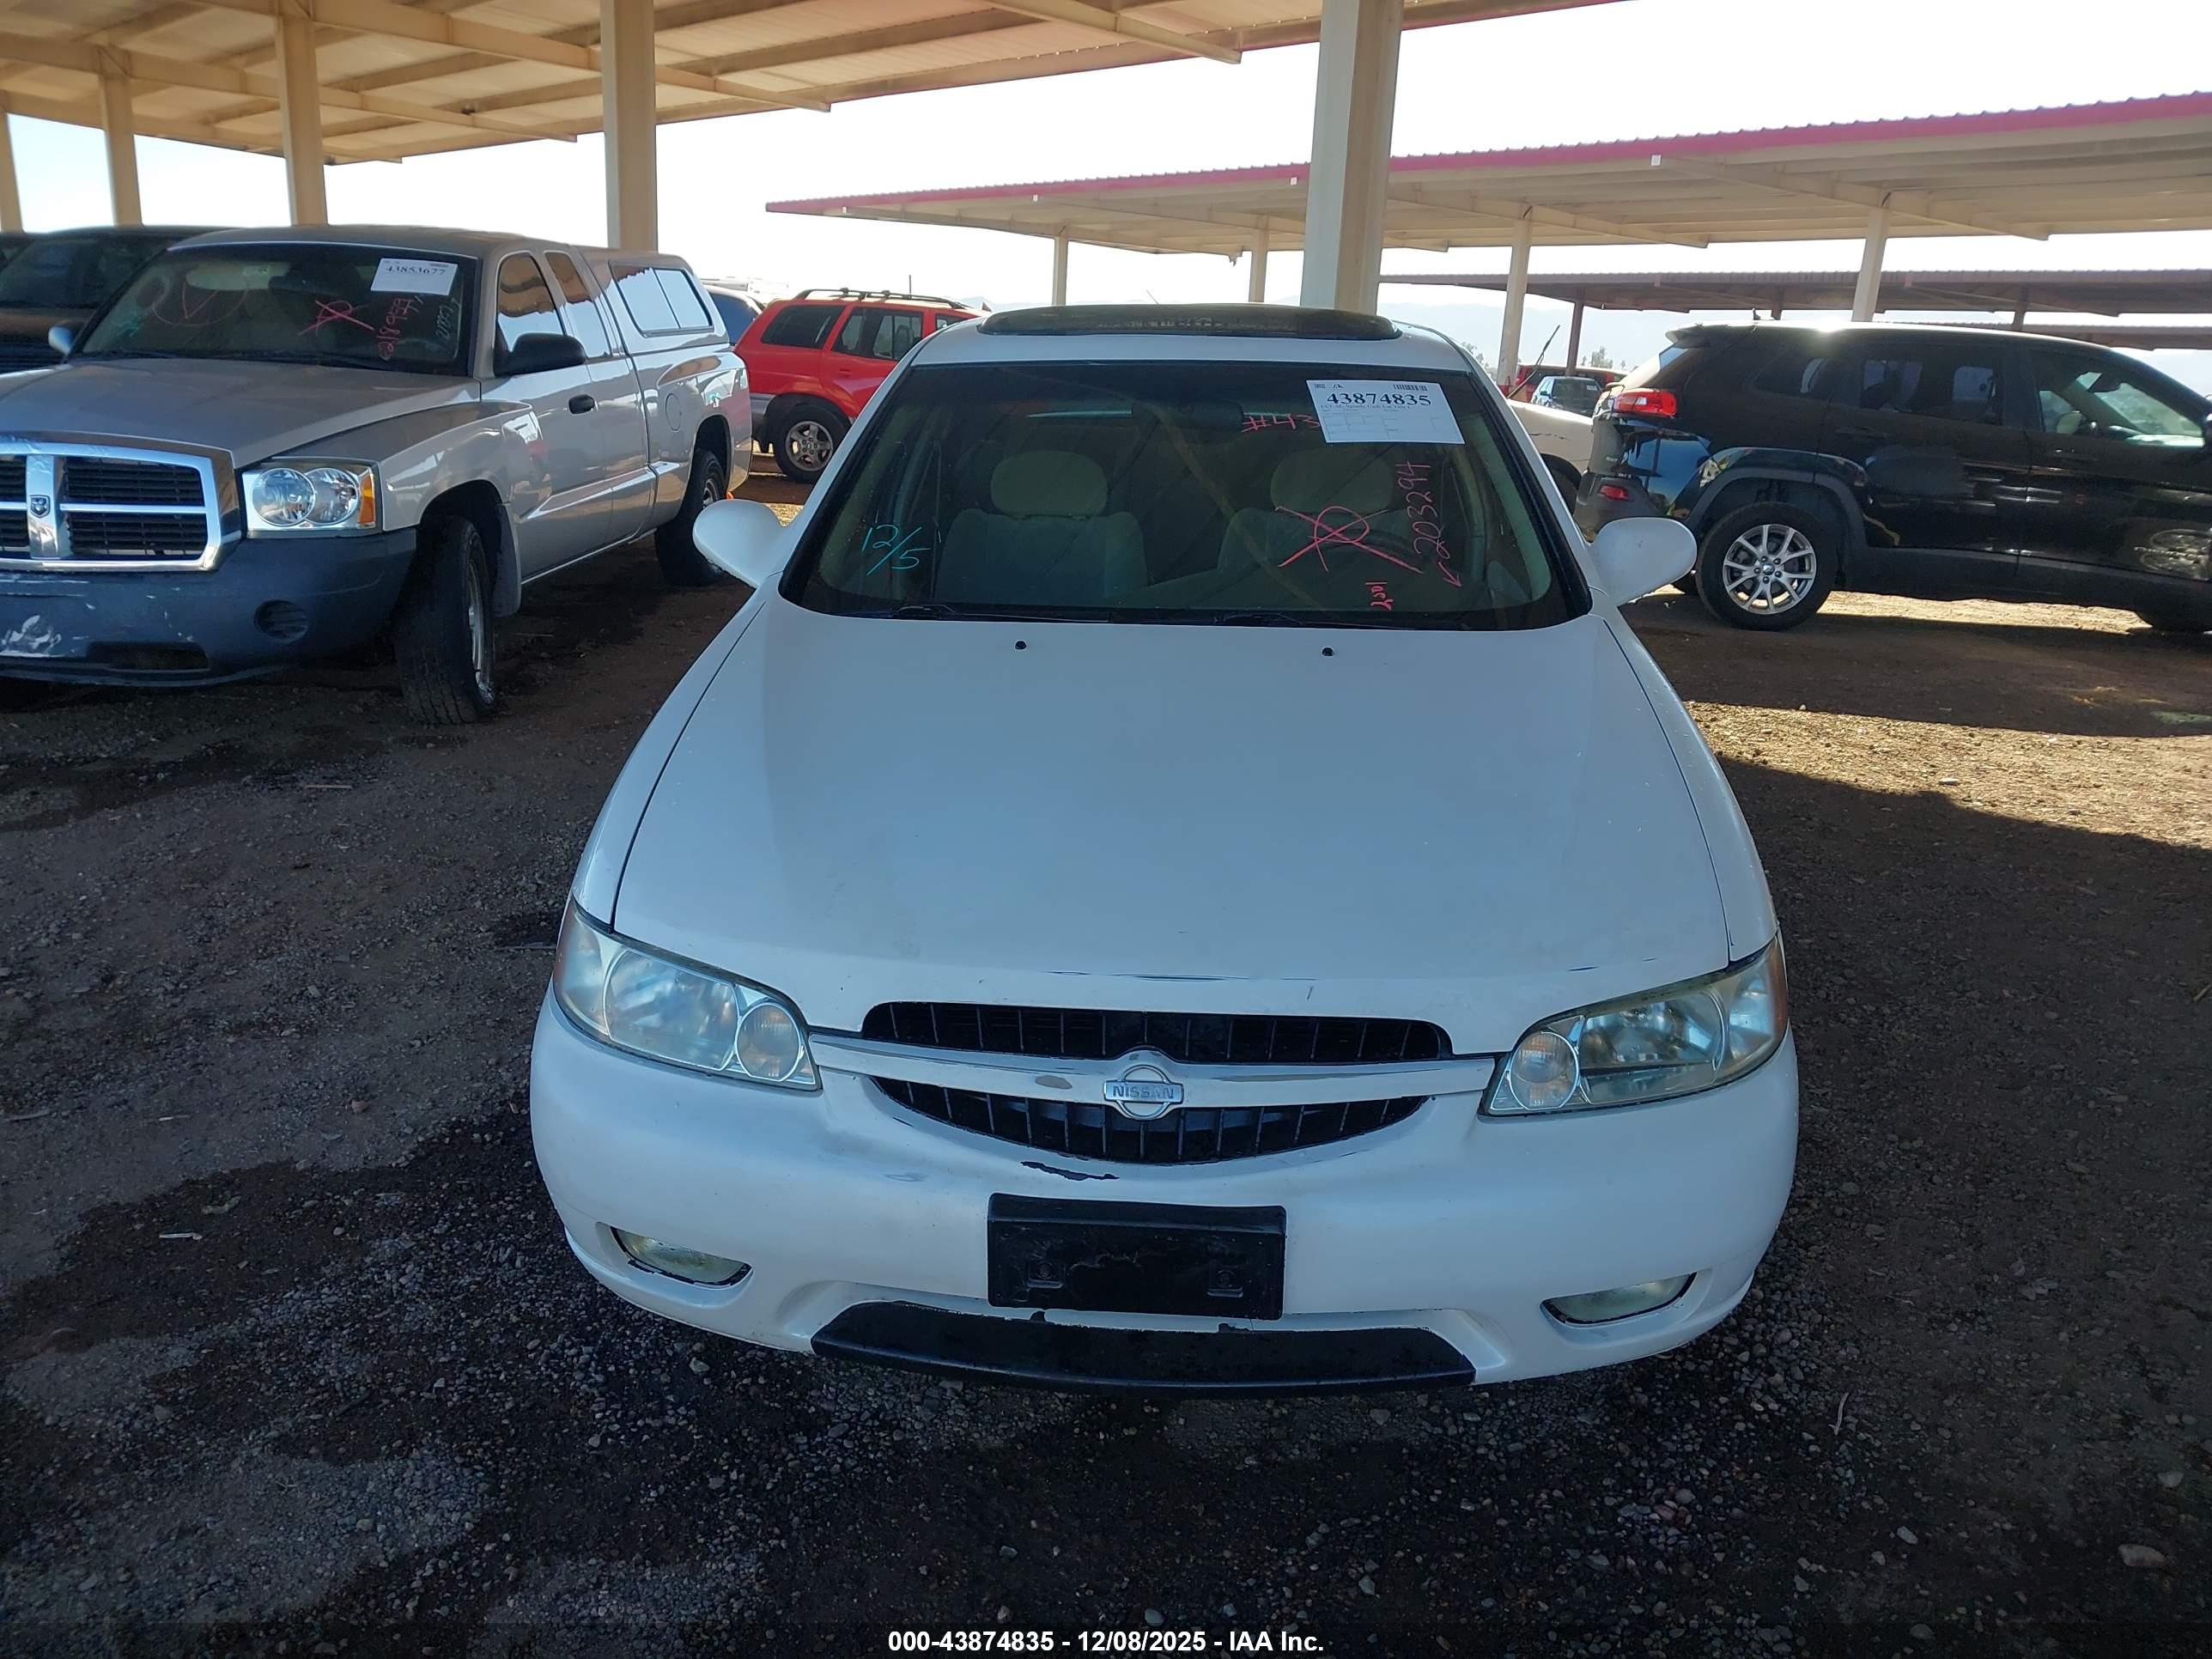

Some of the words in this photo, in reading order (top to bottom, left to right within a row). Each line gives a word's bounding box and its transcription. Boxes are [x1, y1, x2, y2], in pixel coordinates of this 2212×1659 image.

[1327, 392, 1431, 406] 43874835
[1395, 460, 1450, 559] 203294
[861, 524, 932, 575] 12/5
[1112, 1083, 1175, 1099] NISSAN
